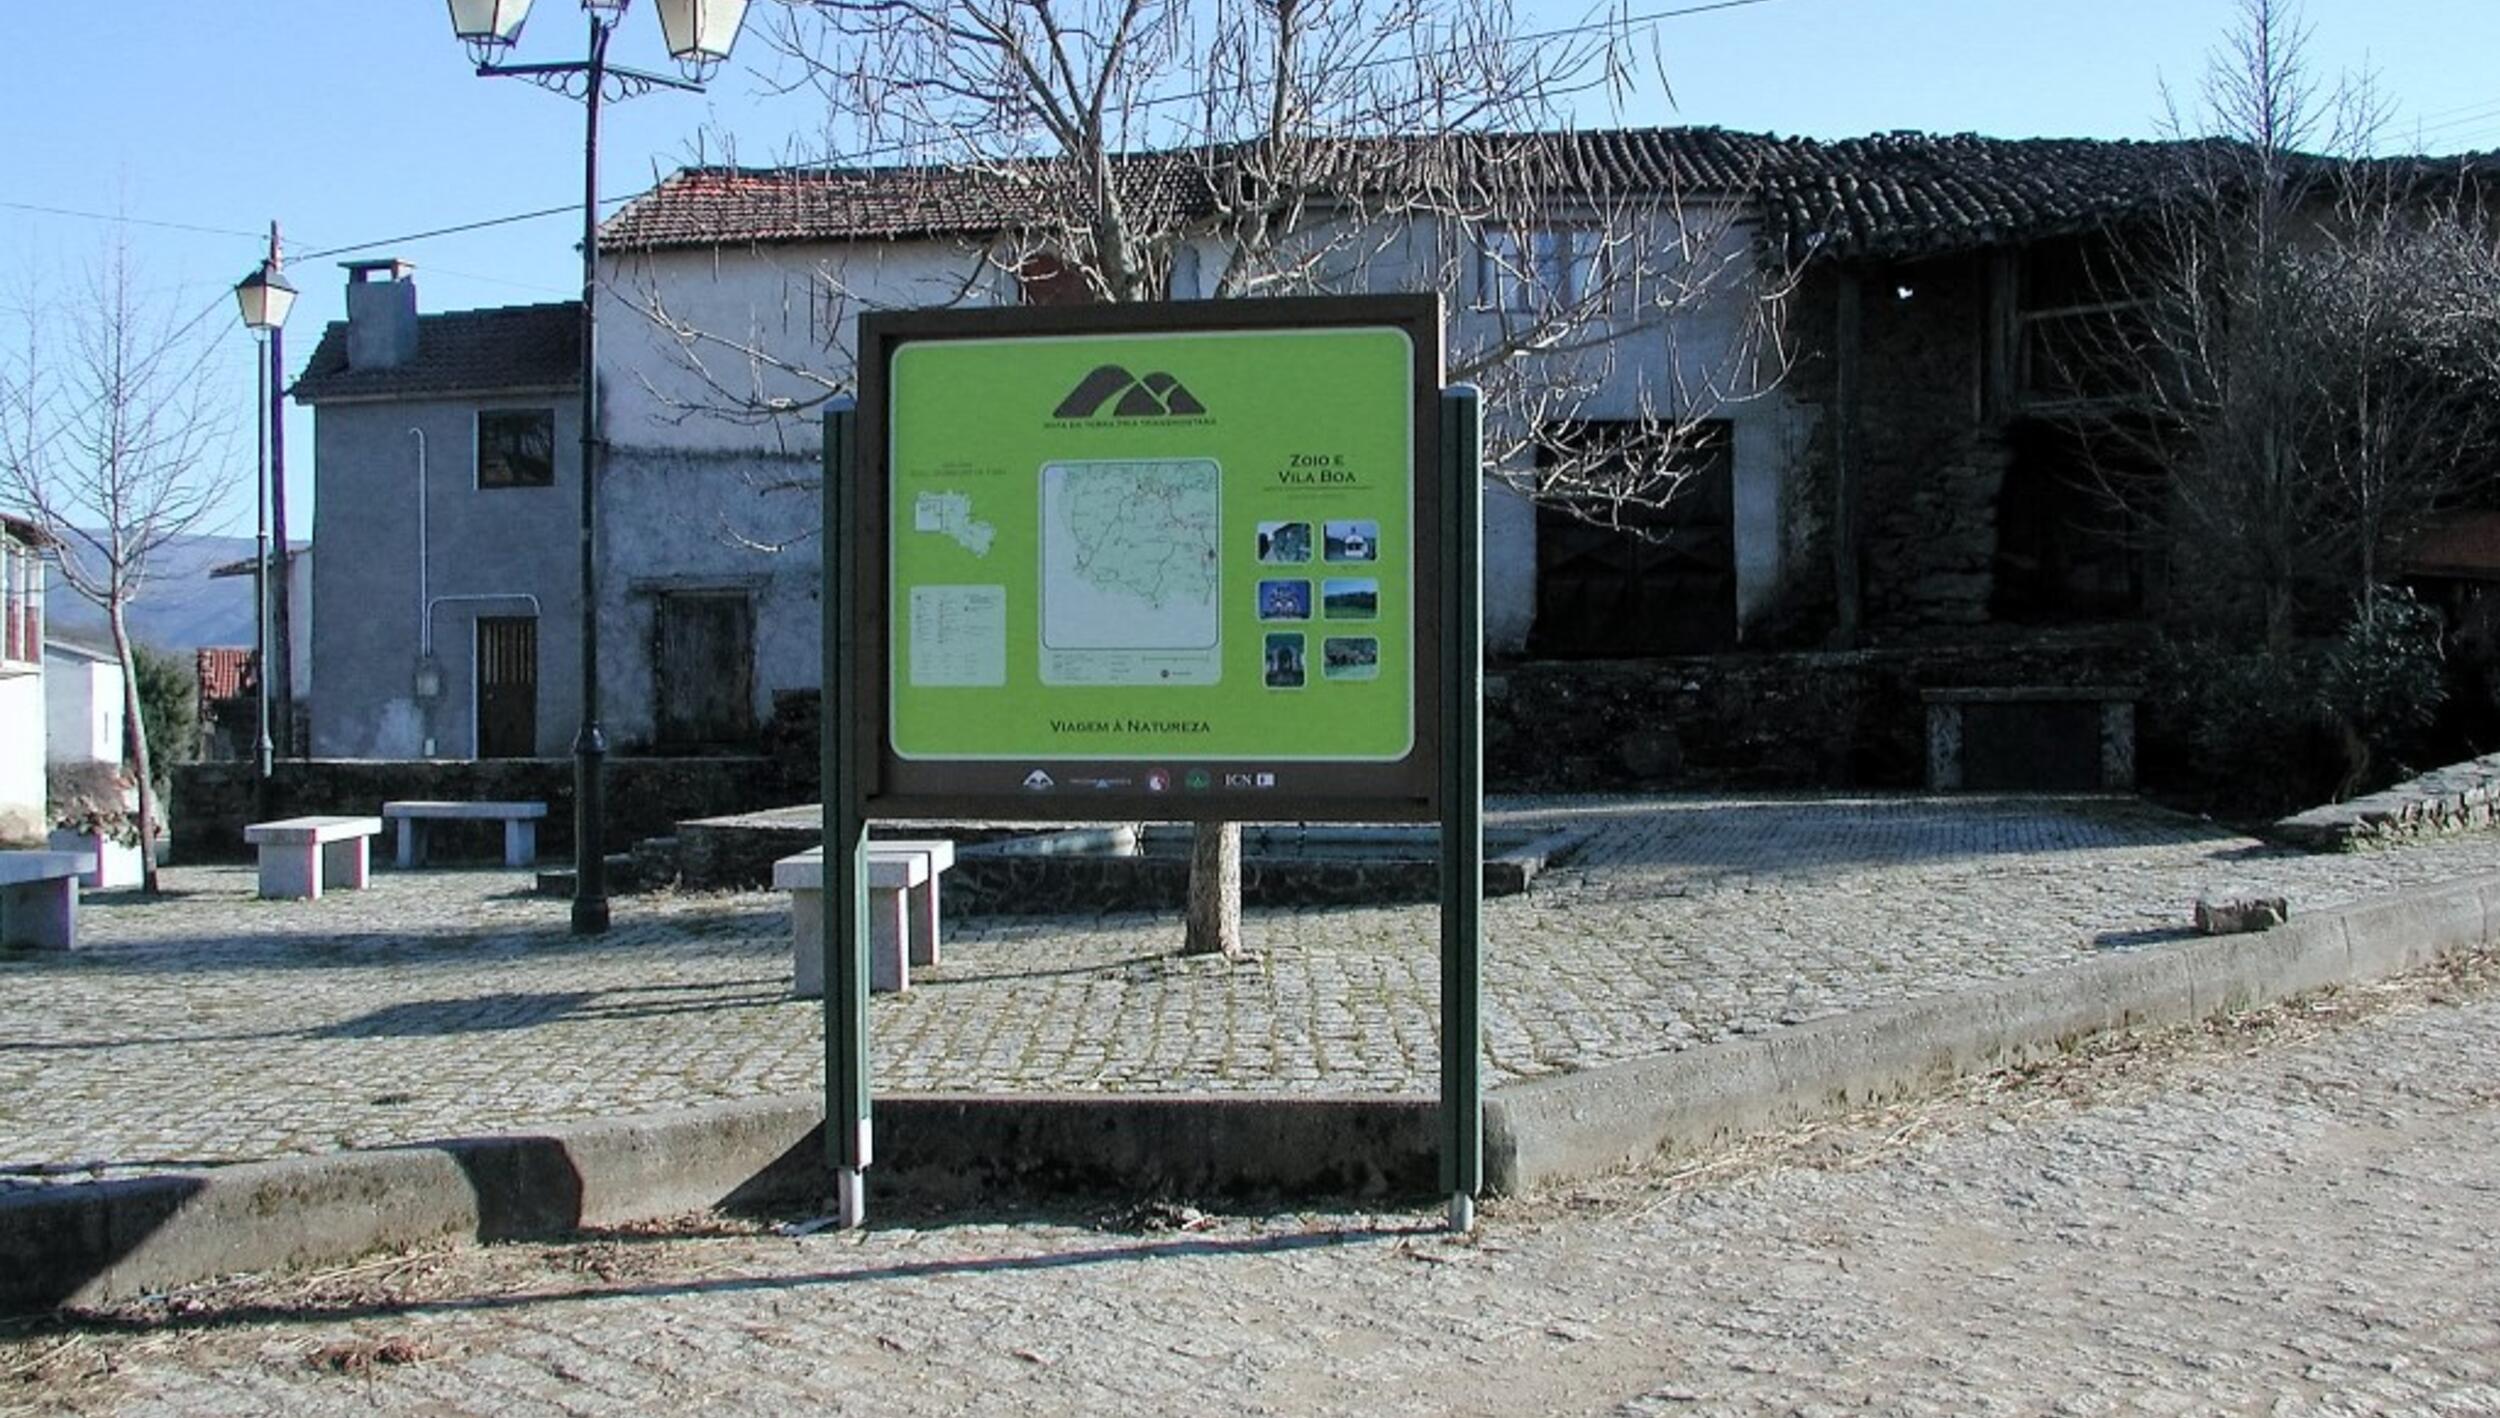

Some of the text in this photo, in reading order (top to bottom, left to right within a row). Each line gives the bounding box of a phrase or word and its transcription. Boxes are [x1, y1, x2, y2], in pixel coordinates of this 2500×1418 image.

[1278, 470, 1356, 483] VILA BOA
[1050, 720, 1109, 733] VIAGEM
[1127, 719, 1211, 733] NATUREZA
